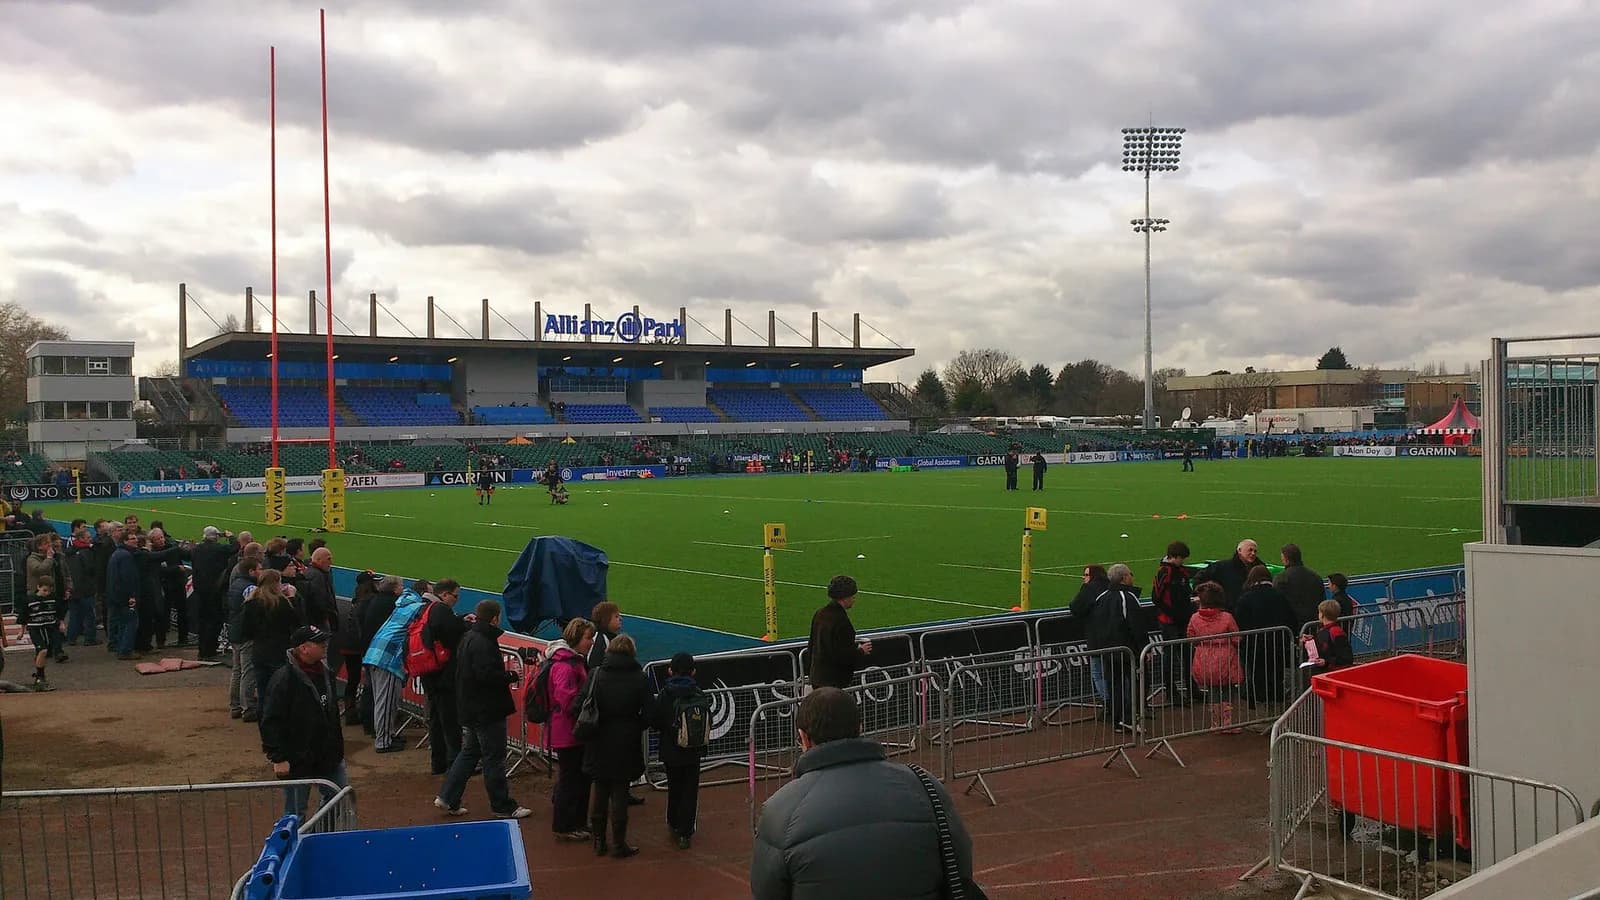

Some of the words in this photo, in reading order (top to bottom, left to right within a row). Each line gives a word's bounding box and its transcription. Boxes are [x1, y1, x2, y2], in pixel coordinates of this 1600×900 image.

[544, 313, 614, 335] Allianz
[644, 318, 685, 337] Park
[1366, 447, 1381, 455] Day
[1409, 447, 1457, 456] GARMIN
[976, 456, 1005, 466] GARM
[1095, 453, 1105, 461] Day
[917, 459, 934, 467] Global
[935, 458, 961, 467] Assistance
[245, 479, 260, 488] Alan
[351, 476, 378, 486] AFEX
[85, 484, 112, 496] SUN
[139, 484, 183, 494] Domino's
[185, 482, 210, 492] Pizza
[273, 481, 283, 522] AVIVA
